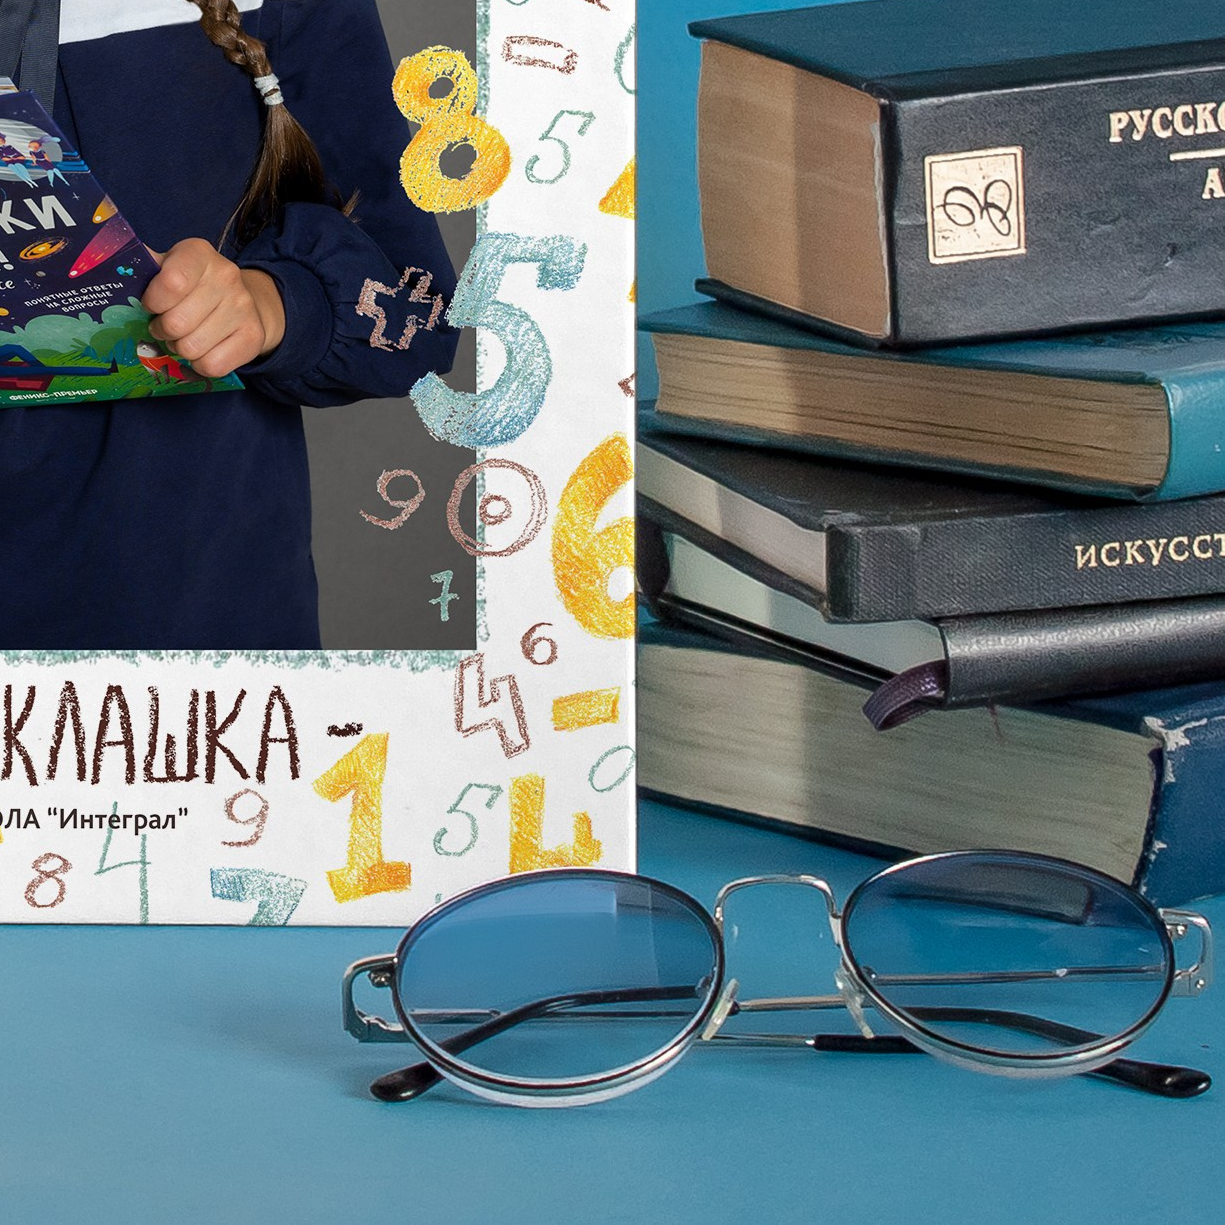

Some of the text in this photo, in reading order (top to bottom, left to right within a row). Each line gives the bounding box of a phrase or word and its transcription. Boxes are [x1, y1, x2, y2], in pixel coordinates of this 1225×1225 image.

[392, 44, 513, 215] 8
[24, 282, 124, 307] ПОНЯТНЫЕ ОТВЕТЫ
[45, 291, 113, 309] НА СЛОЖНЫЕ
[61, 299, 109, 313] ВОПРОСЫ
[409, 231, 588, 450] 5
[312, 732, 412, 905] 1
